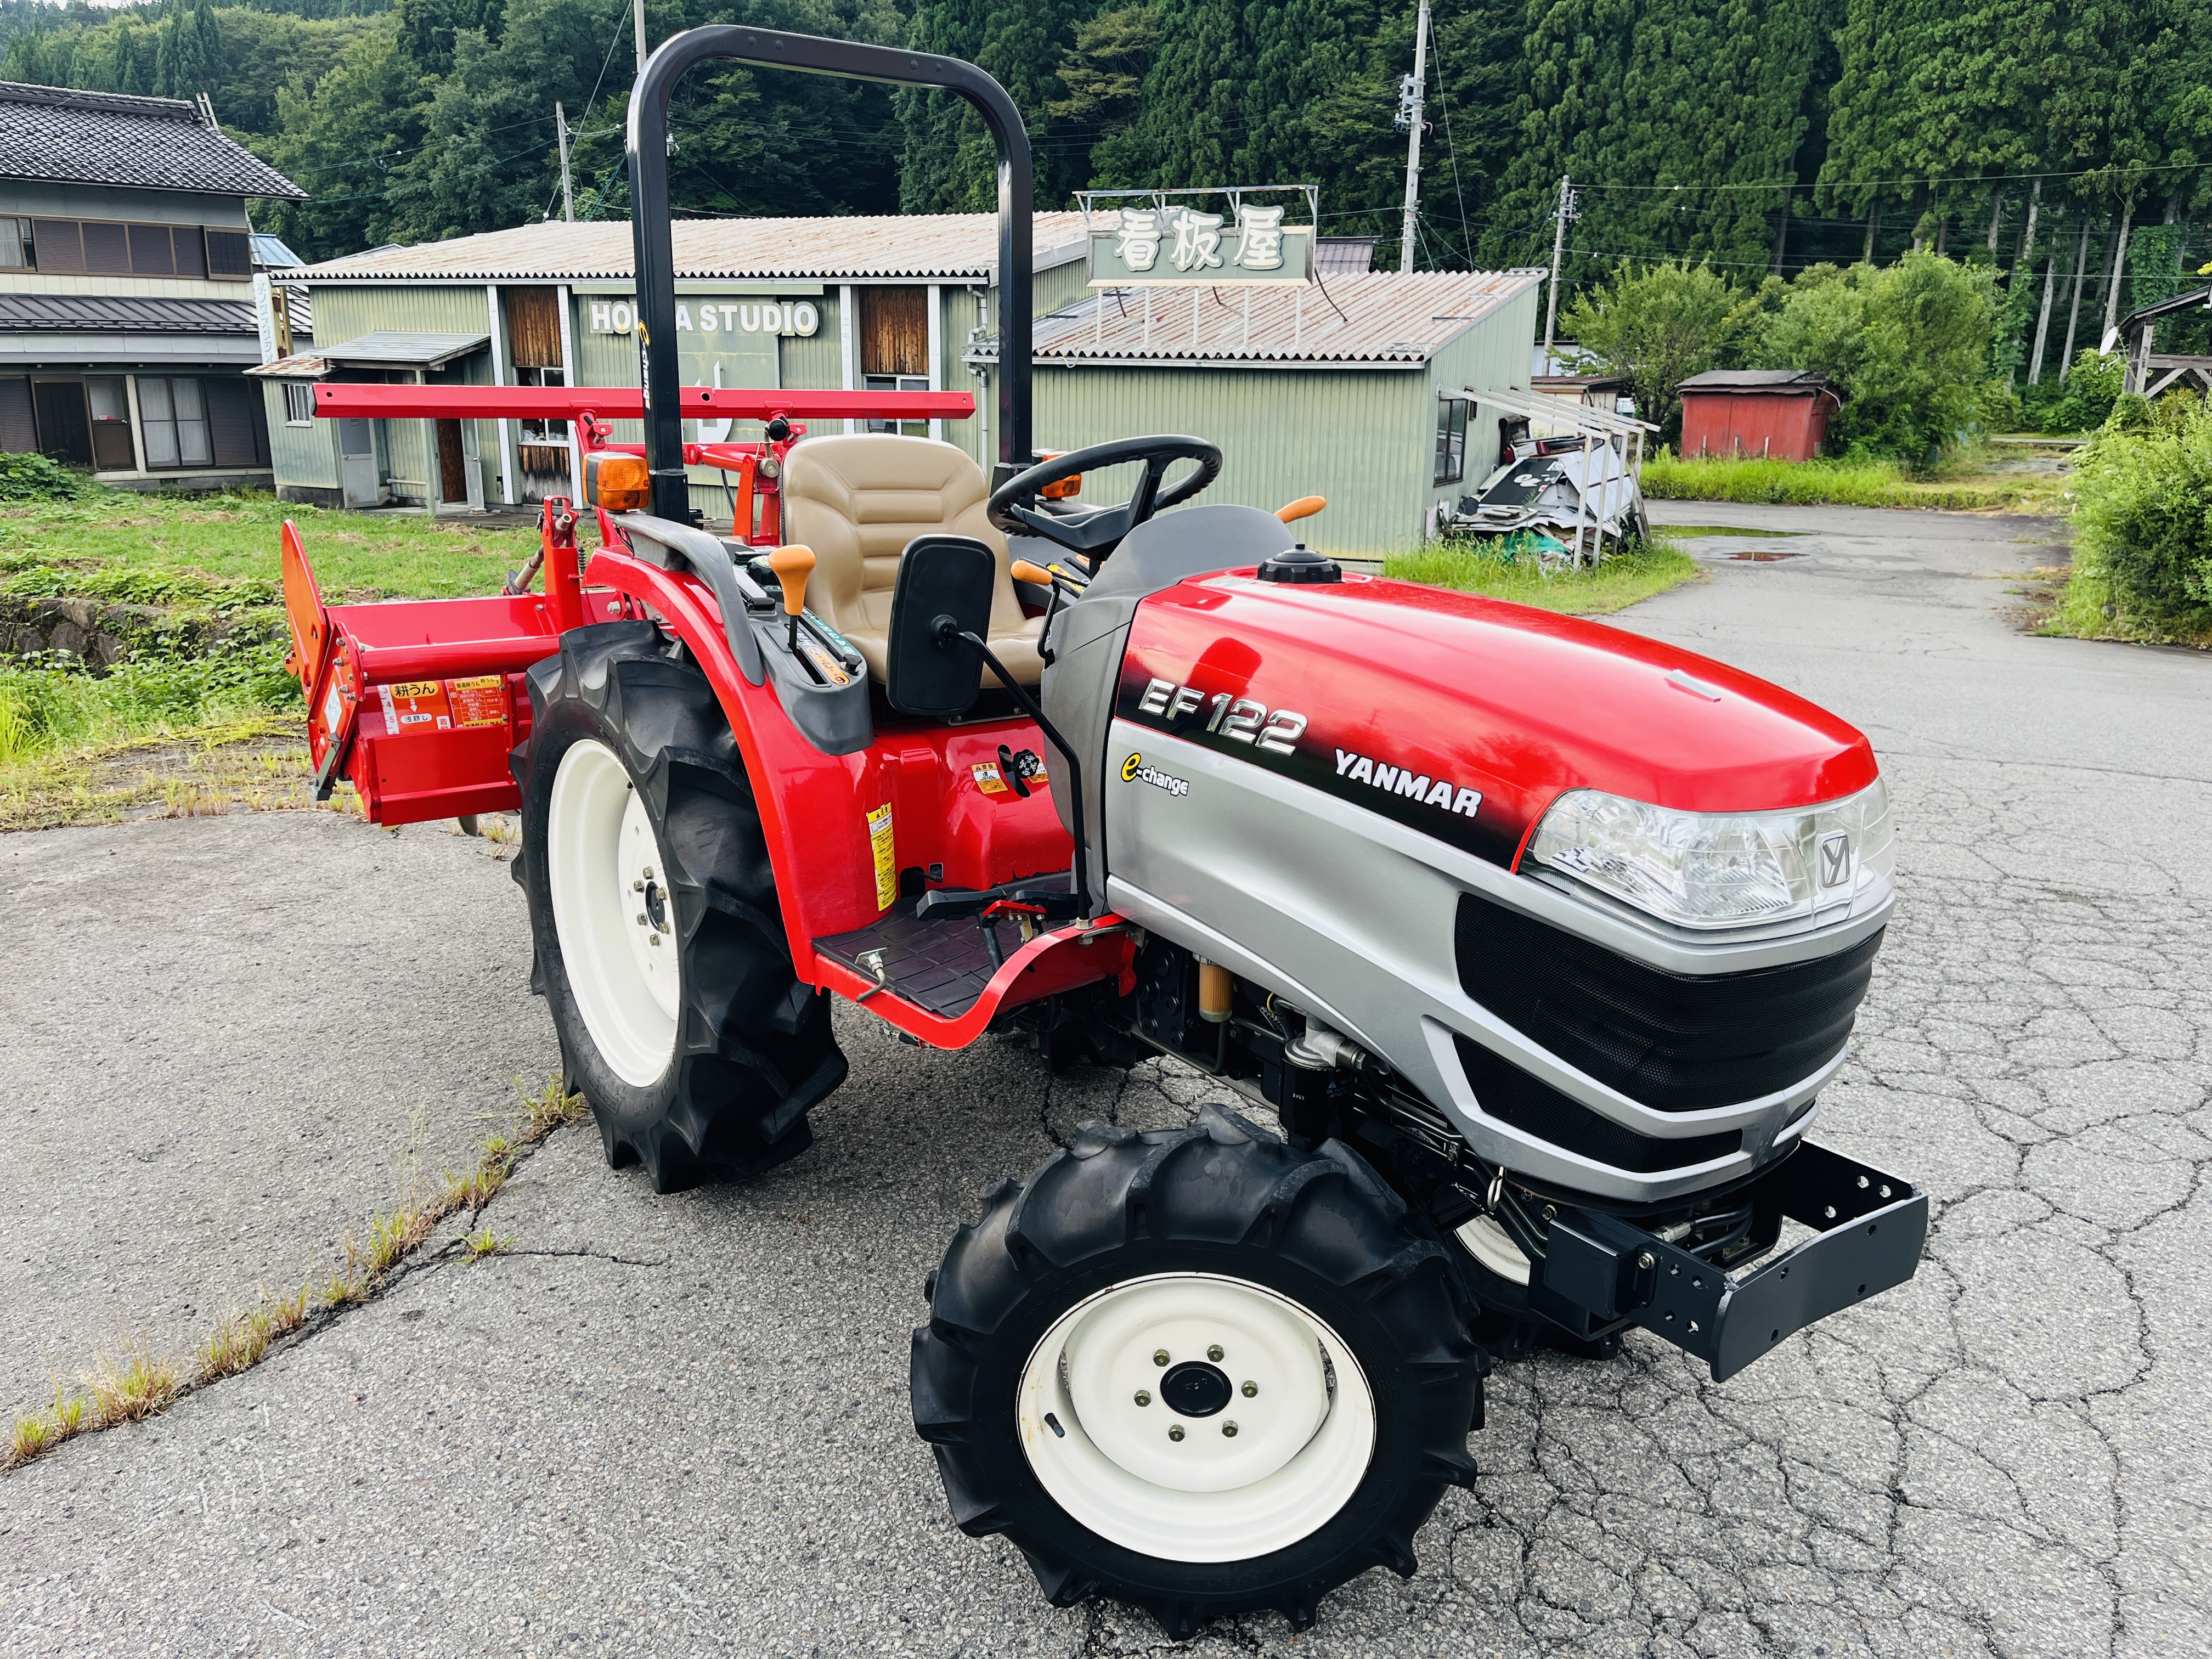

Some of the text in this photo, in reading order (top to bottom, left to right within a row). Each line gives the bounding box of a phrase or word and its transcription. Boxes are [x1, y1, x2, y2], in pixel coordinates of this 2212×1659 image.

[1114, 207, 1283, 269] 看板屋
[699, 303, 817, 332] STUDIO
[394, 683, 435, 697] 耕うん
[1138, 678, 1308, 756] EF 122
[1121, 753, 1189, 797] e-change
[1335, 747, 1483, 818] YANMAR
